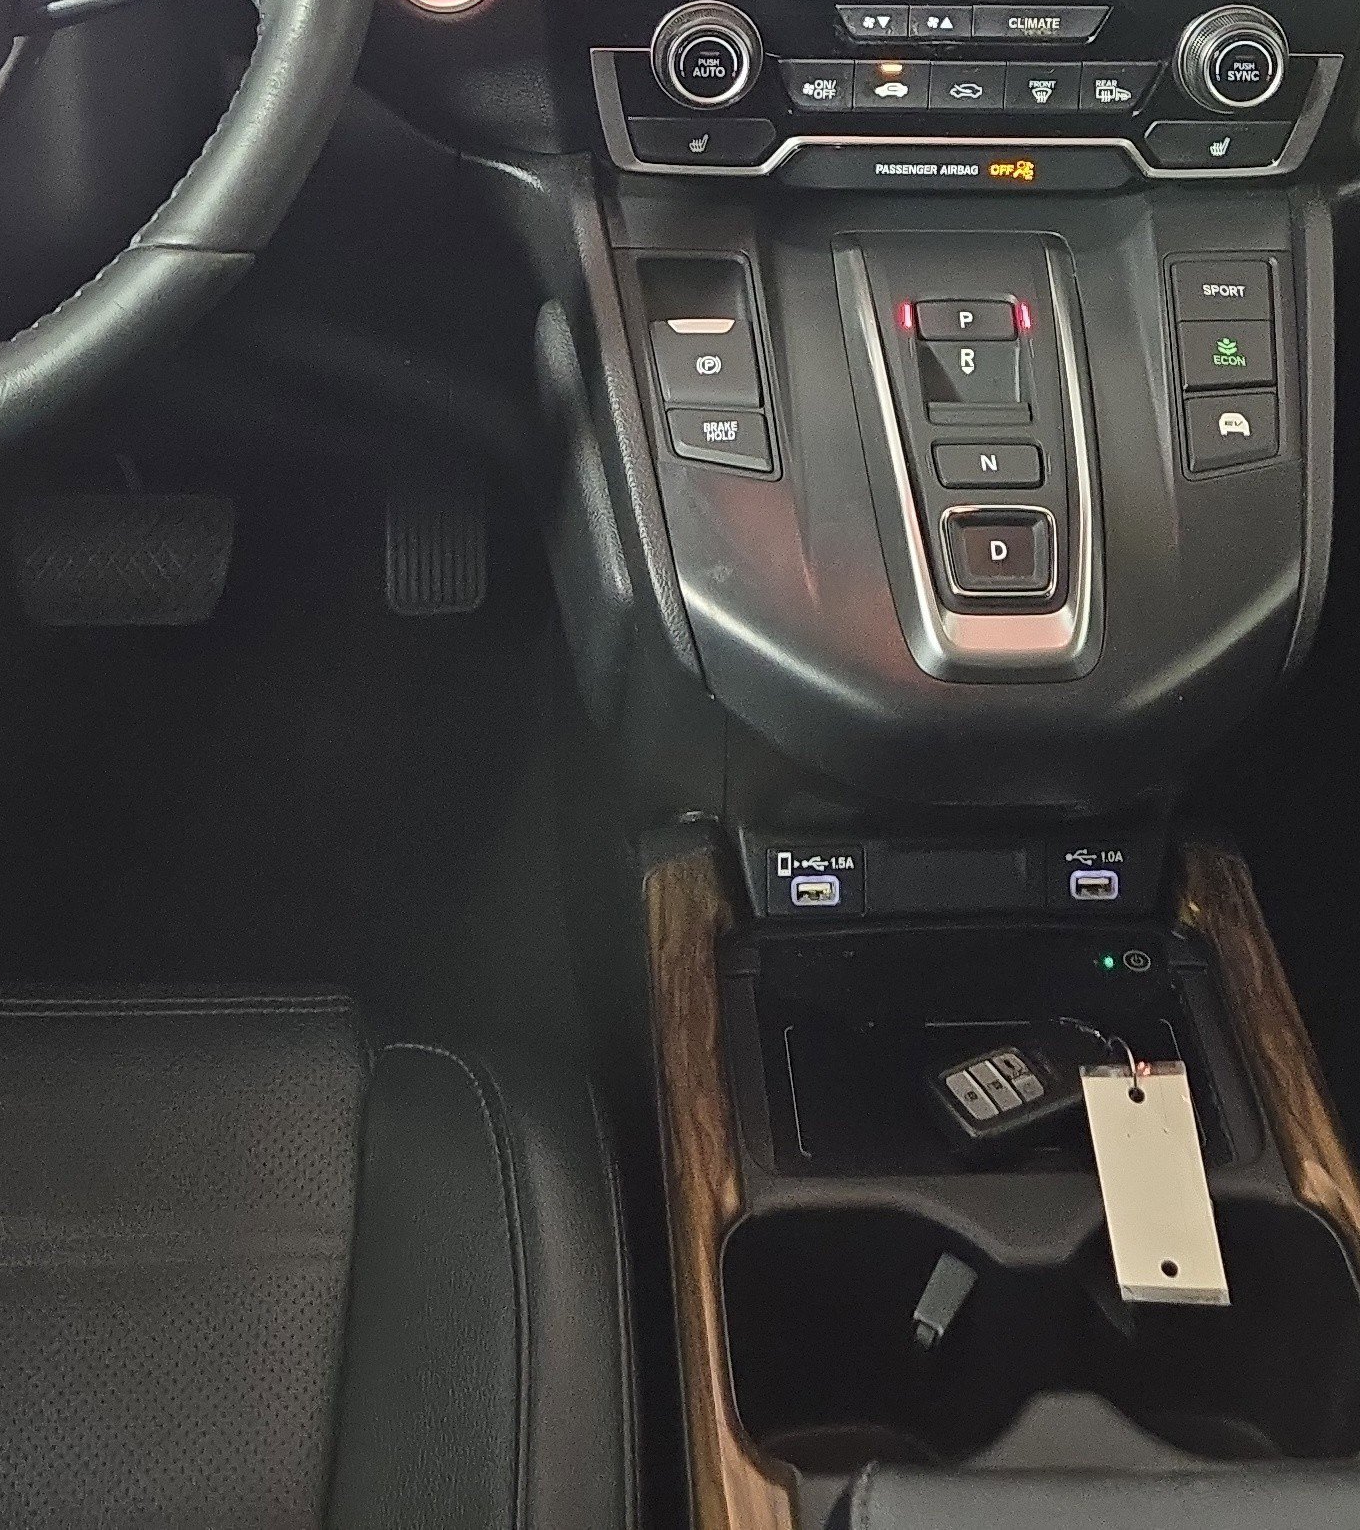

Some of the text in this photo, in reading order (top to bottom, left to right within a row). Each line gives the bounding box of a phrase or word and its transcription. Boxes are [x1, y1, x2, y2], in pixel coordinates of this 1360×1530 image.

[1008, 17, 1061, 30] CLIMATE
[698, 58, 720, 67] PUSH
[1234, 62, 1256, 70] PUSH
[692, 66, 726, 78] AUTO
[1227, 70, 1260, 82] SYNC
[1028, 80, 1057, 89] FRONT
[1095, 79, 1118, 88] REAR
[814, 88, 837, 100] OFF
[875, 164, 1015, 176] PASSENGER AIRBAG OFF
[1202, 283, 1246, 298] SPORT
[959, 311, 974, 329] P
[960, 348, 975, 368] R
[1212, 354, 1247, 367] ECON
[703, 420, 738, 432] BRAKE
[706, 430, 736, 441] HOLD
[979, 454, 999, 472] N
[989, 539, 1009, 562] D
[1099, 849, 1124, 864] 1.0A
